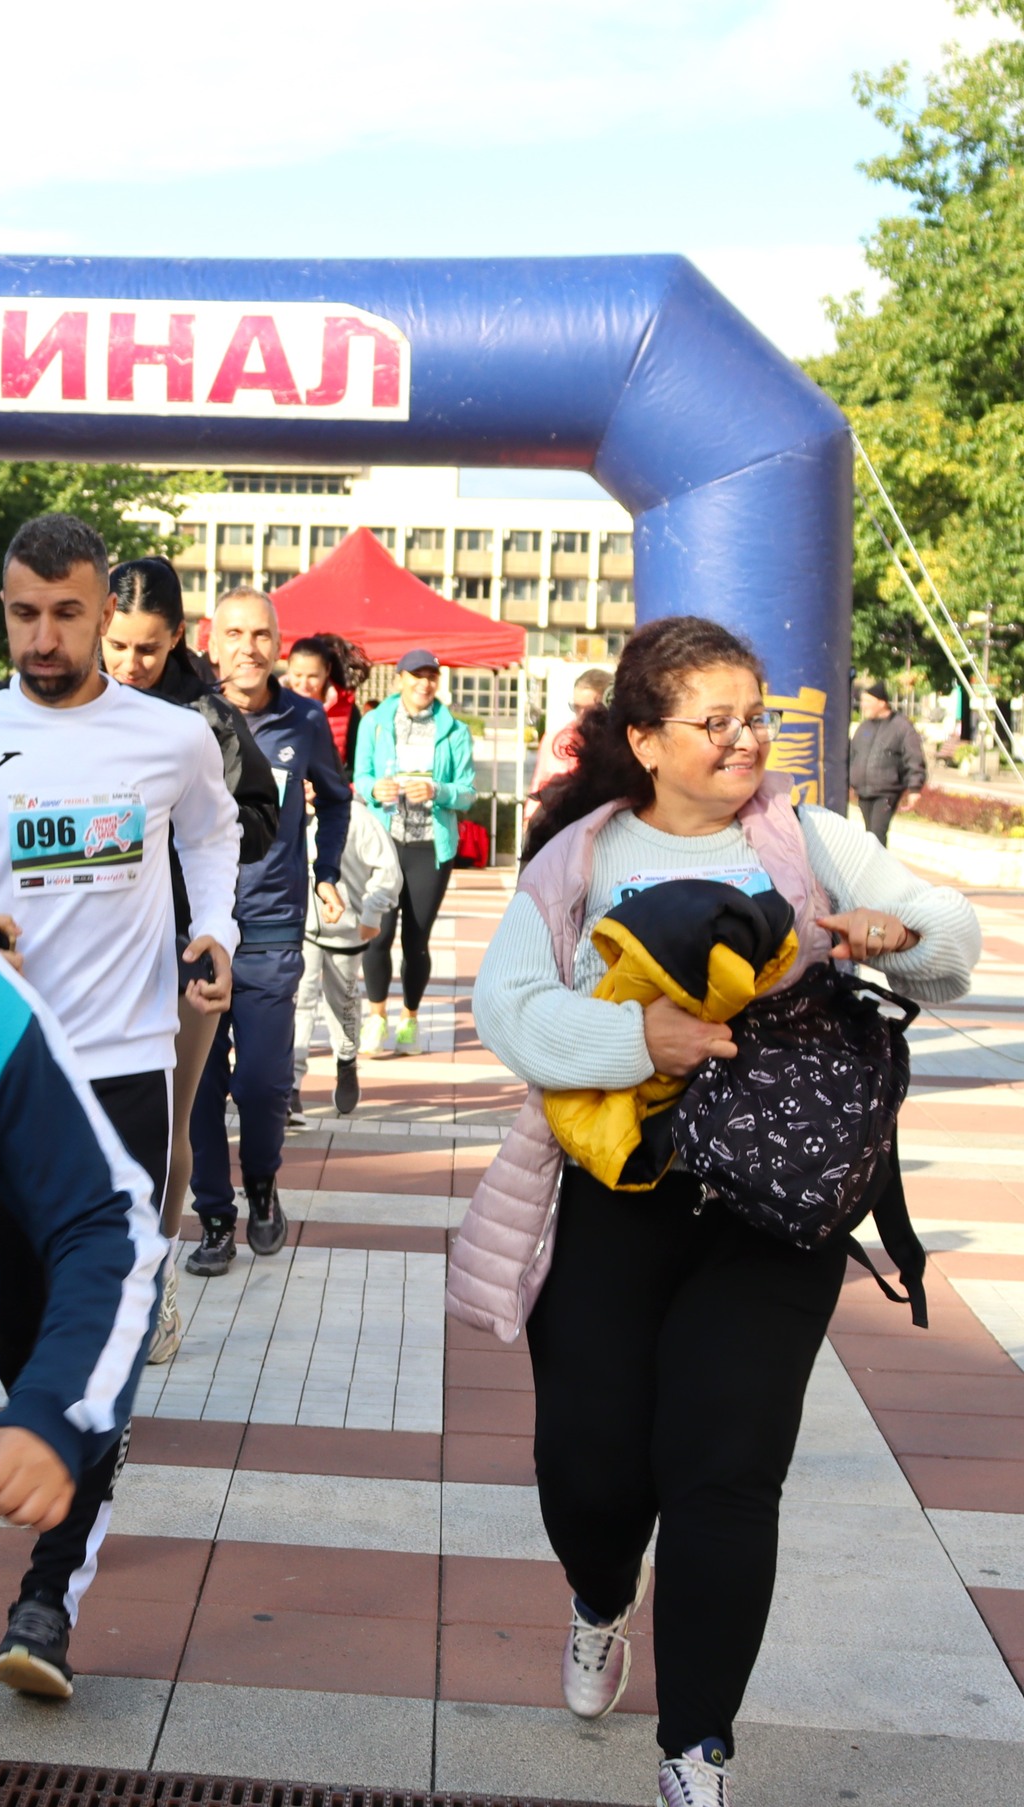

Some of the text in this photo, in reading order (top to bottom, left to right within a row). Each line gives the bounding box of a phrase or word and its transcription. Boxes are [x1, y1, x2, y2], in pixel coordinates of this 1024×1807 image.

[16, 816, 76, 850] 096
[814, 1088, 833, 1106] GOAL
[767, 1130, 788, 1148] GOAL
[769, 1179, 787, 1199] GOAL
